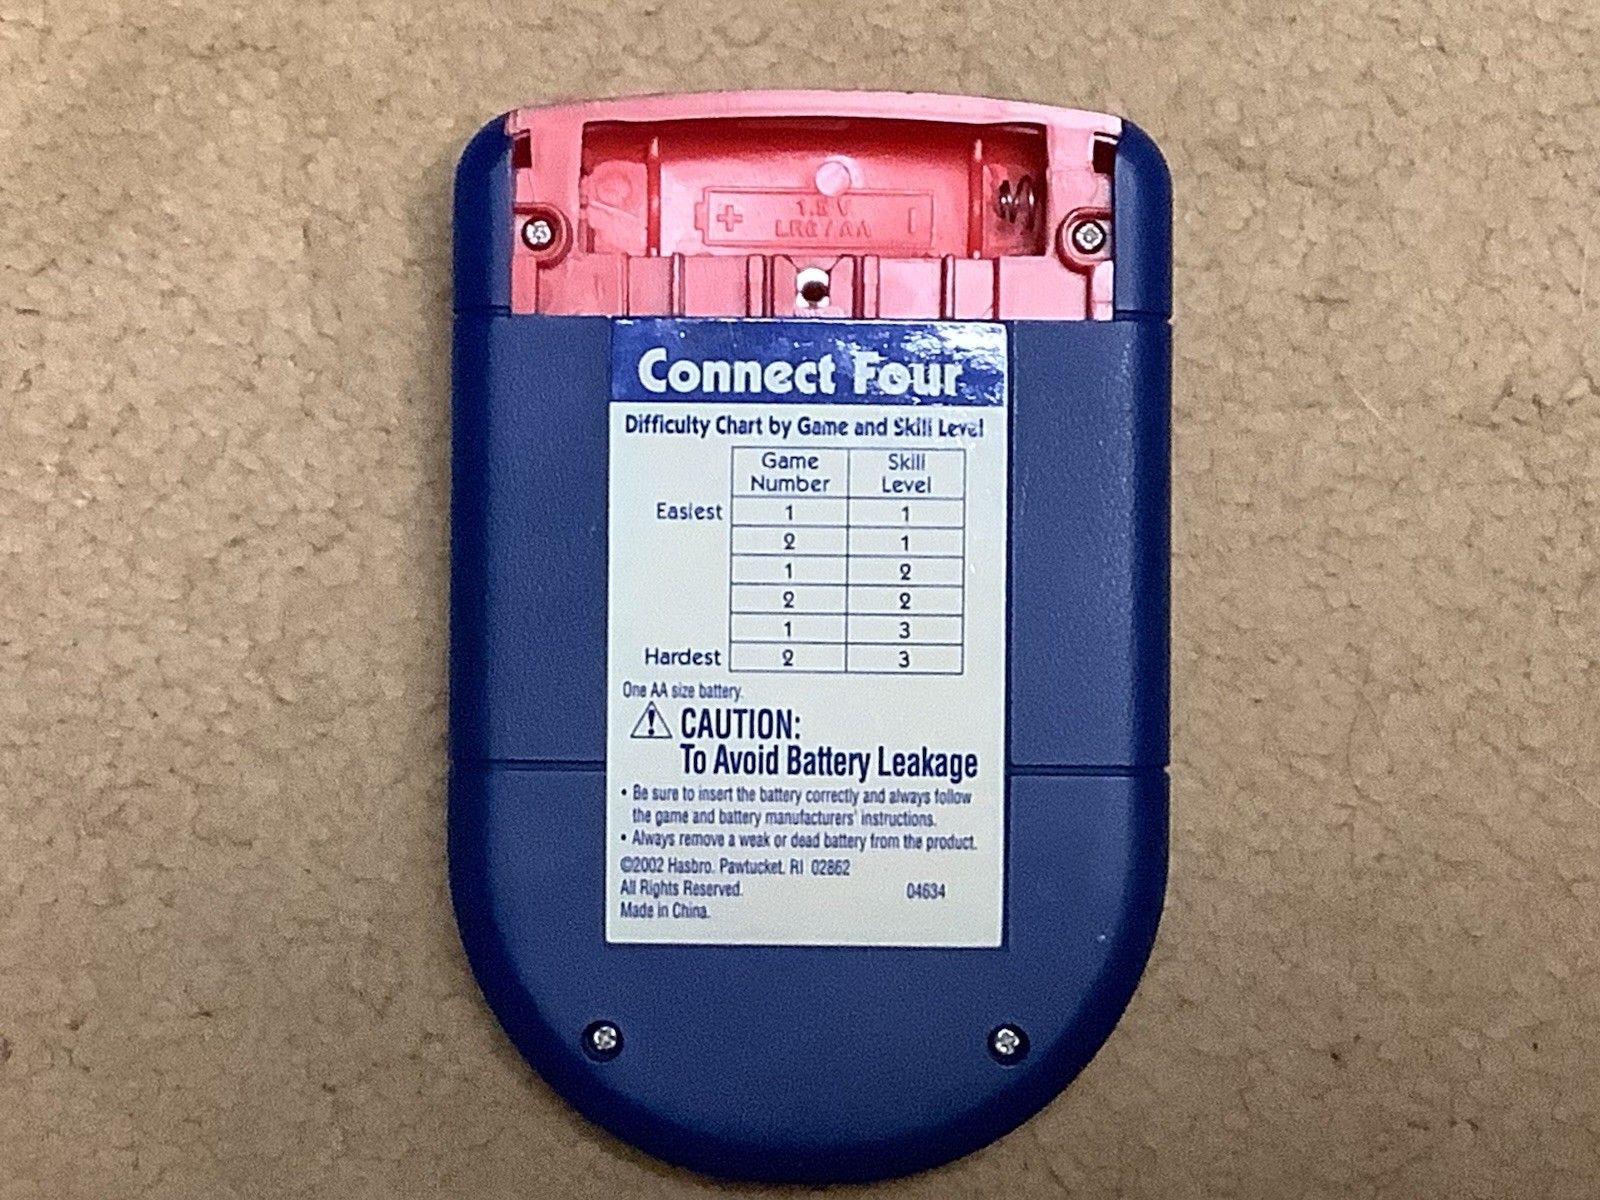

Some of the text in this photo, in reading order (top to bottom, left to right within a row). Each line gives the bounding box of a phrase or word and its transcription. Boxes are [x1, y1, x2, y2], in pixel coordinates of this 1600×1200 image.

[637, 348, 965, 396] Connect Four
[625, 414, 984, 441] Difficulty Chart by Game and Skill Level
[761, 453, 819, 470] Game
[888, 454, 926, 471] Skill
[750, 476, 830, 493] Number
[882, 476, 932, 494] Level
[656, 502, 910, 521] Easiest 1 1
[783, 533, 910, 551] 2 1
[785, 563, 912, 580] 1 2
[783, 591, 912, 609] 2 2
[784, 622, 911, 639] 1 3
[644, 648, 911, 668] Hardest 2 3
[622, 681, 744, 703] One AA size battery.
[680, 707, 801, 740] CAUTION:
[680, 743, 978, 784] To Avoid Battery Leakage
[633, 784, 972, 808] Be sure to insert the battery correctly and always follow
[633, 809, 652, 825] the
[655, 812, 691, 827] game
[693, 809, 715, 825] and
[718, 809, 762, 828] battery
[861, 811, 937, 828] instructions.
[632, 830, 977, 853] Always remove a weak or dead battery from the product.
[790, 859, 804, 875] RI
[810, 860, 851, 876] 02862
[620, 879, 743, 898] All Rights Reserved.
[906, 882, 946, 900] 04634
[620, 902, 710, 919] Made in China.
